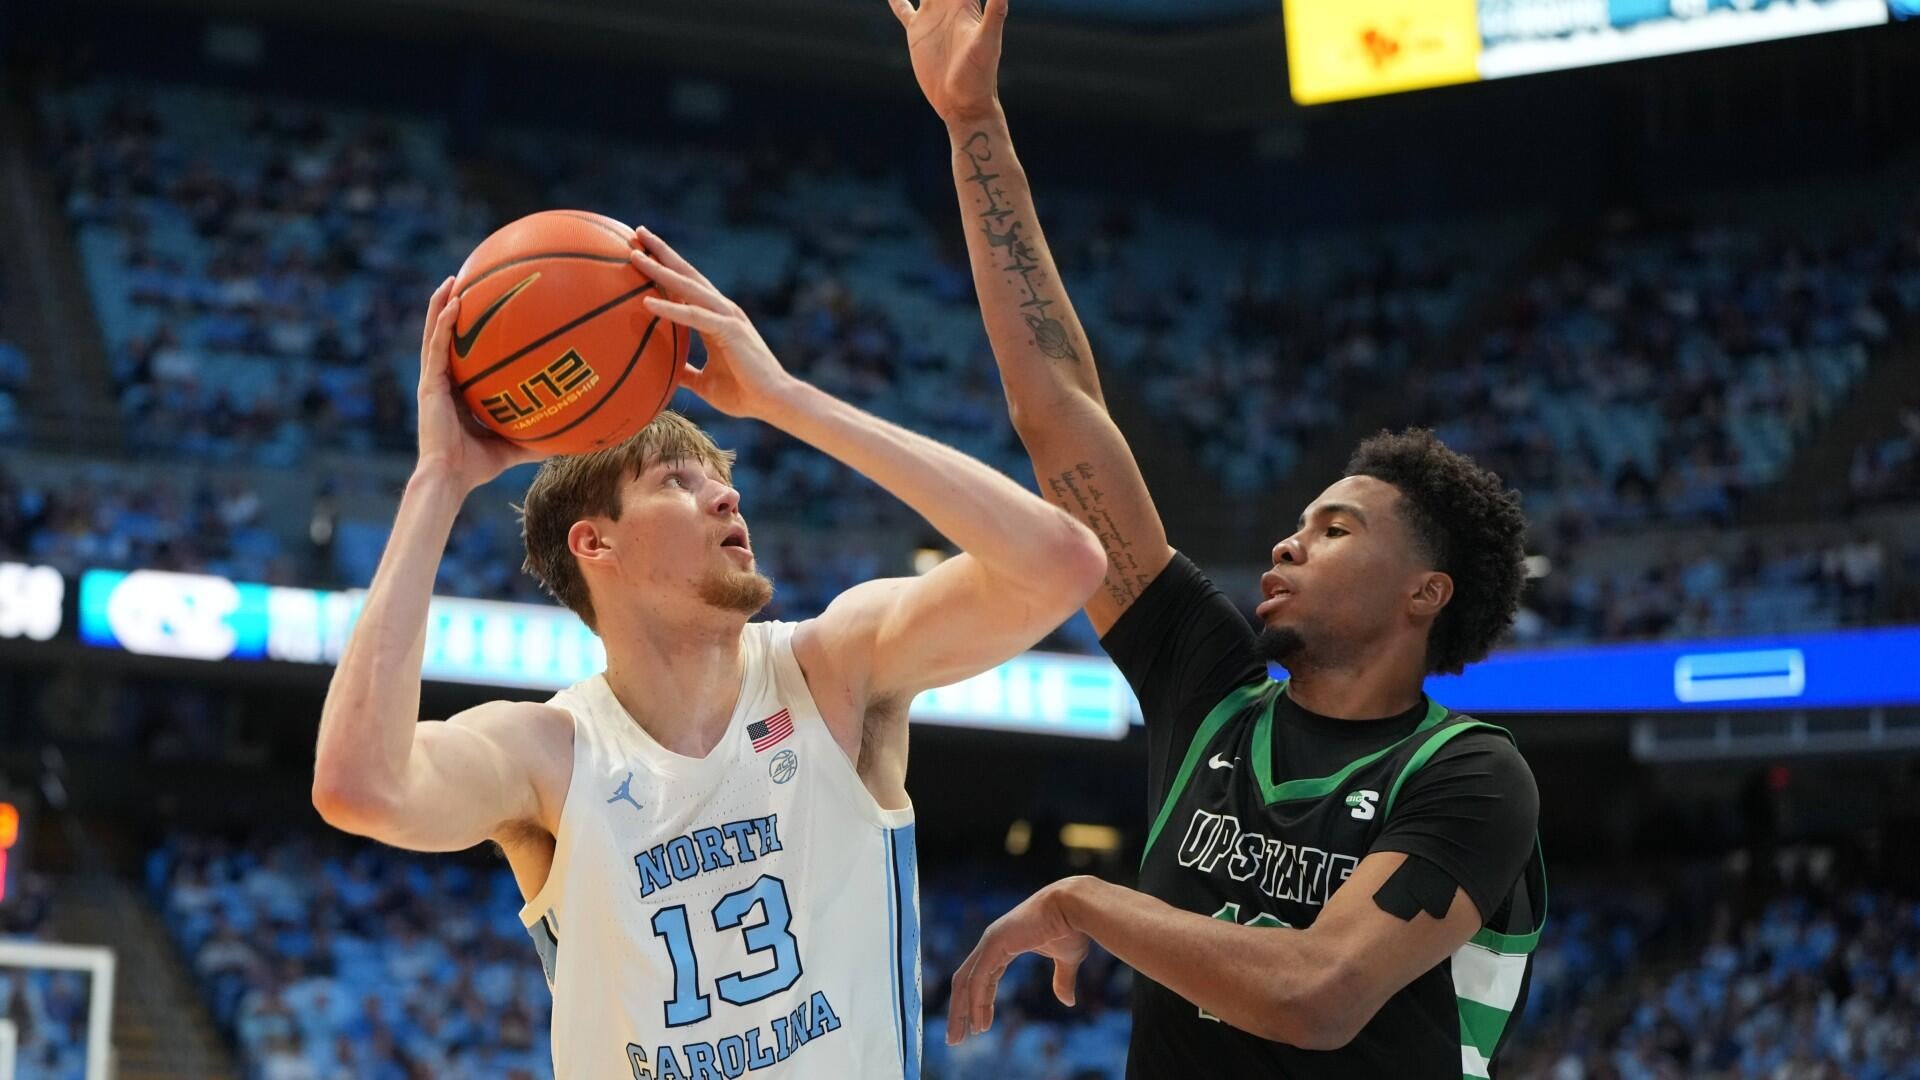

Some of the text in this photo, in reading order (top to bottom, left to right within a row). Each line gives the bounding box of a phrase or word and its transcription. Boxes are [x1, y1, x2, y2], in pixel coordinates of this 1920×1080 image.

[481, 347, 594, 424] ELITE
[511, 375, 600, 431] AMPIONSHIP
[634, 813, 783, 899] NORTH
[650, 873, 804, 1028] 13
[626, 990, 842, 1080] CAROLINA
